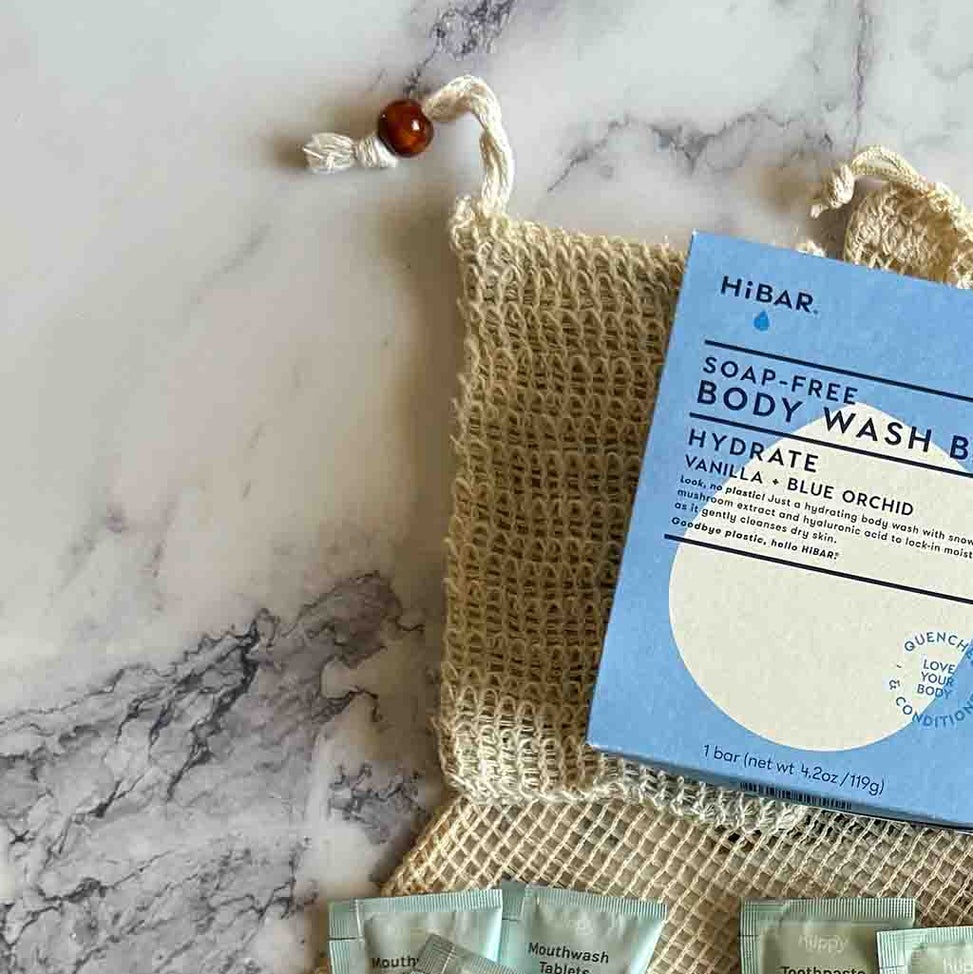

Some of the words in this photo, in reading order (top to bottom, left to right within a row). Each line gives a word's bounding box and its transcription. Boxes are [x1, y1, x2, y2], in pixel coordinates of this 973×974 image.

[702, 356, 859, 405] SOAP-FREE
[697, 379, 803, 423] BODY
[824, 406, 932, 453] WASH
[688, 428, 819, 473] HYDRATE
[685, 454, 763, 484] VANILLA
[772, 478, 780, 486] +
[787, 477, 835, 500] BLUE
[842, 489, 914, 516] ORCHID
[674, 502, 688, 510] as
[690, 502, 700, 513] it
[701, 508, 737, 524] gently
[740, 516, 788, 534] cleanses
[790, 525, 810, 540] dry
[812, 532, 837, 544] skin.
[677, 488, 734, 508] mushroom
[736, 501, 776, 517] extract
[778, 511, 800, 522] and
[803, 515, 861, 536] hyaluronic
[864, 529, 889, 541] acid
[891, 533, 902, 544] to
[905, 536, 941, 552] lock-in
[680, 475, 707, 489] Look,
[709, 482, 723, 491] no
[725, 486, 767, 502] plastic!
[767, 494, 791, 507] Just
[793, 501, 801, 509] a
[804, 502, 858, 523] hydrating
[861, 514, 889, 530] body
[891, 520, 919, 534] wash
[922, 528, 946, 540] with
[671, 516, 722, 535] Goodbye
[724, 530, 767, 546] plastic,
[771, 538, 798, 552] hello
[921, 671, 955, 688] YOUR
[923, 658, 956, 675] LOVE
[917, 683, 953, 700] BODY
[703, 744, 710, 757] 1
[713, 745, 741, 763] bar
[743, 751, 773, 770] (net
[776, 762, 796, 775] wt
[371, 954, 420, 970] Mouth
[527, 942, 609, 964] Mouthwash
